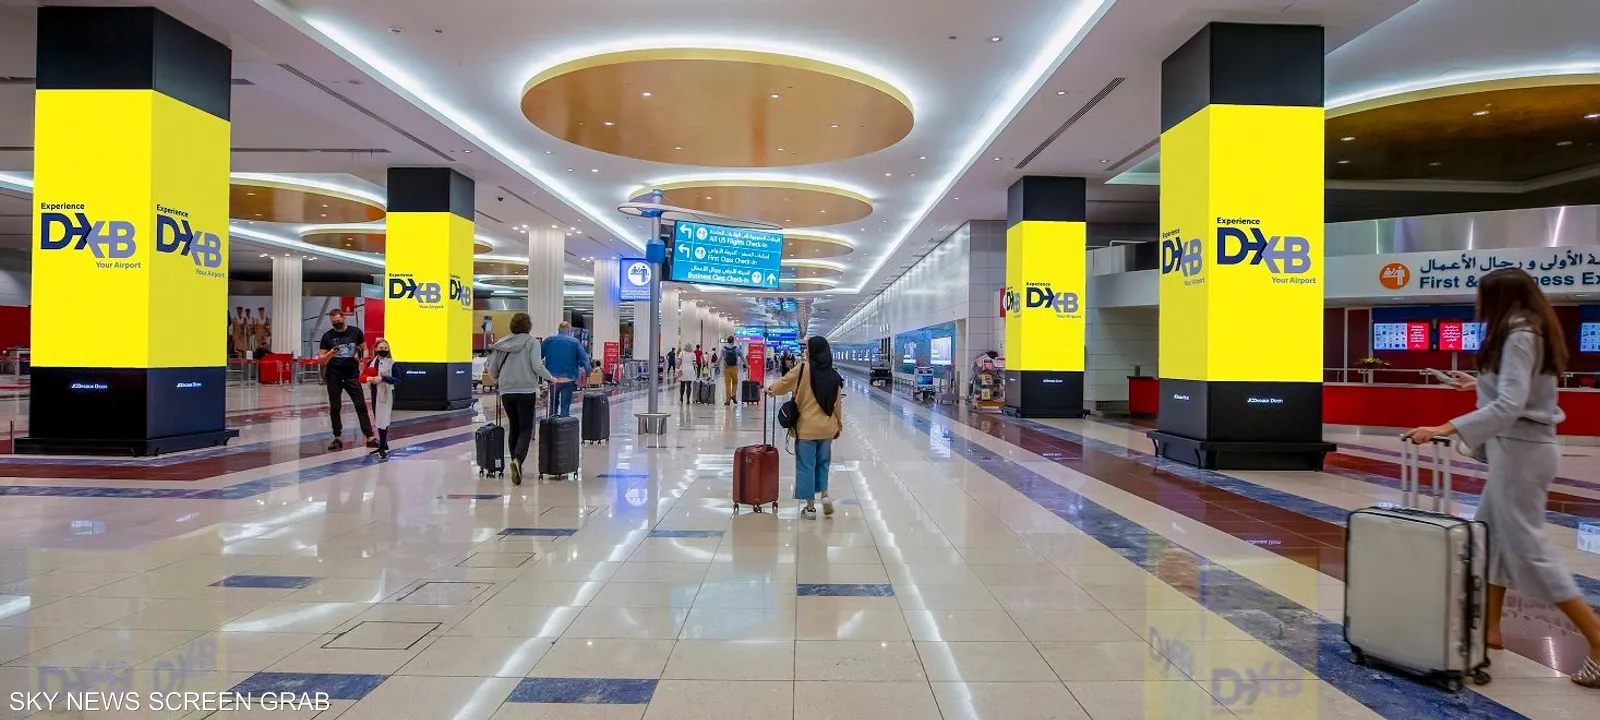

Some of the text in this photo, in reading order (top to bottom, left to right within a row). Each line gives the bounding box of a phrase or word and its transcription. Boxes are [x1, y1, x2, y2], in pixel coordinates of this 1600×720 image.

[40, 202, 85, 211] Experience
[156, 204, 188, 218] Experience
[1217, 217, 1260, 225] Experience
[40, 213, 136, 258] DXB
[156, 213, 222, 269] DXB
[727, 237, 744, 247] Flights
[1217, 227, 1311, 274] DXB
[96, 261, 141, 270] Your Airport
[687, 272, 711, 280] Business
[1290, 277, 1316, 285] Airport
[1420, 276, 1459, 289] First
[1465, 276, 1478, 288] &
[389, 279, 441, 303] DXB
[1026, 287, 1078, 313] DXB
